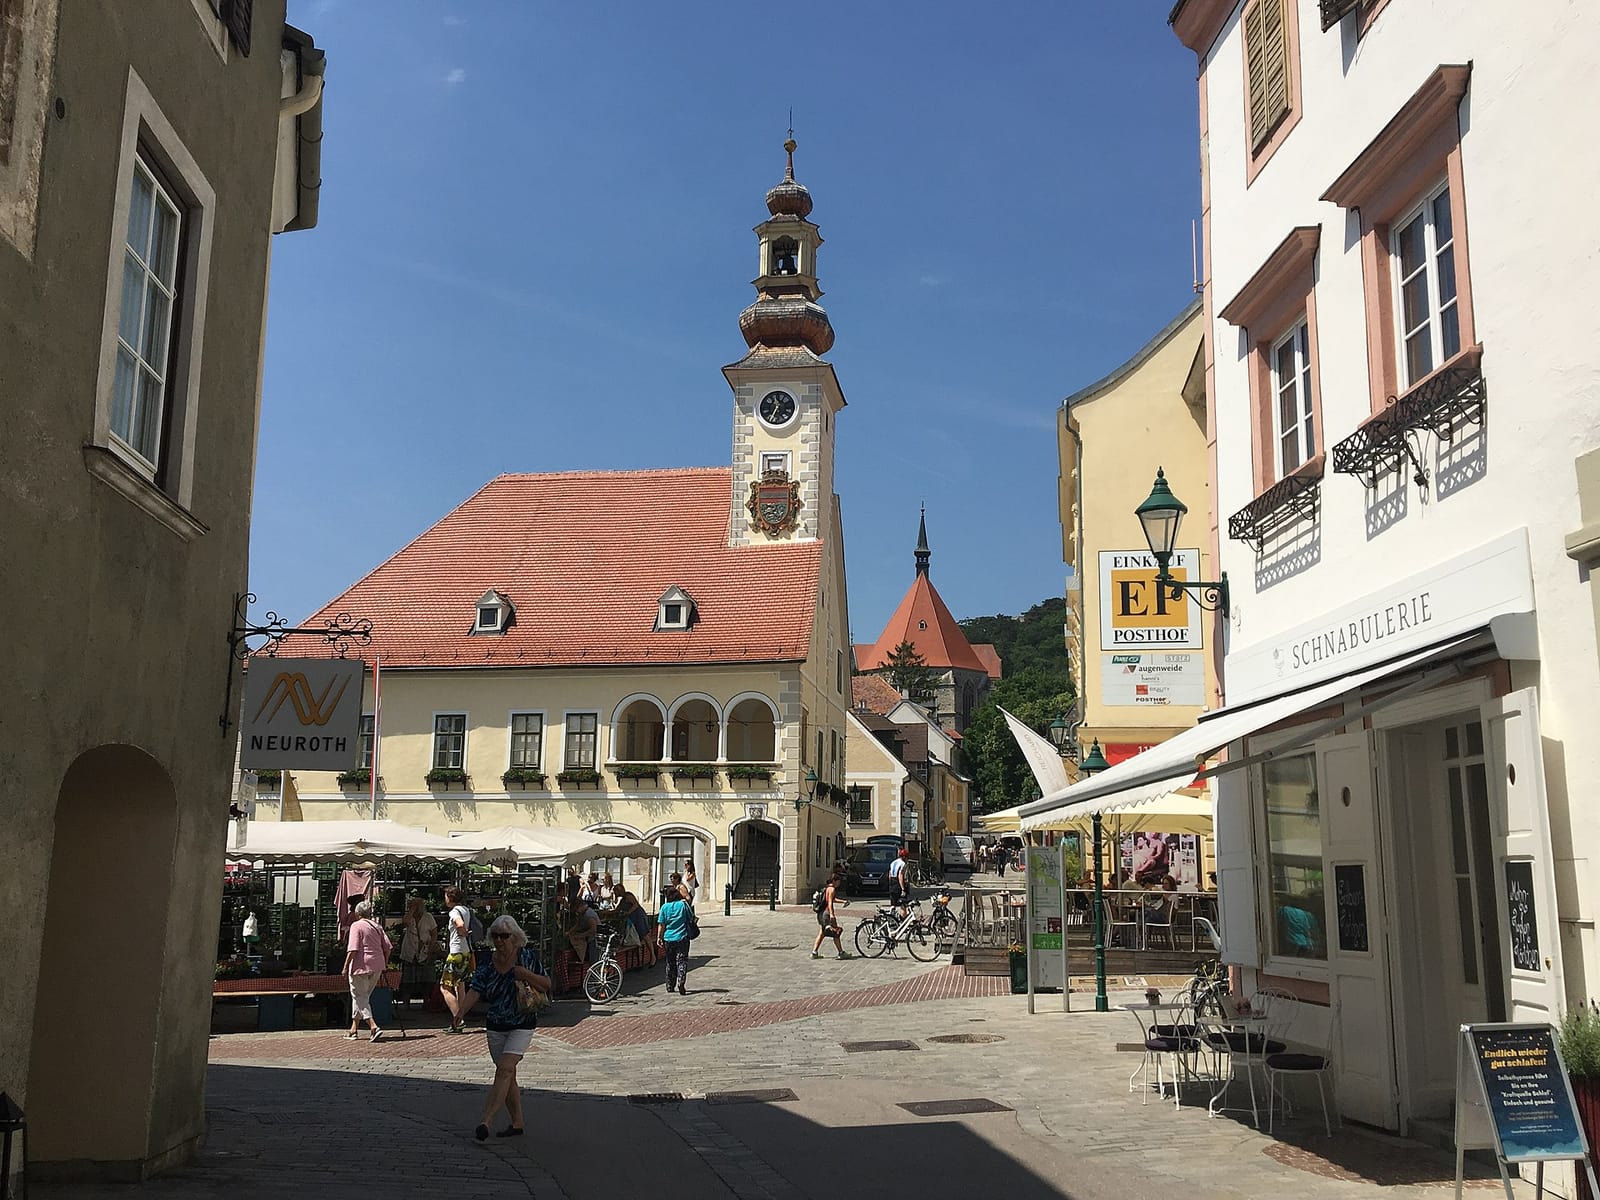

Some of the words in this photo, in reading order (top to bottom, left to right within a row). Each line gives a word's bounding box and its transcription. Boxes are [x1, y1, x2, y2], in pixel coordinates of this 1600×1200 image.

[1113, 554, 1186, 568] EINKUF
[1114, 628, 1189, 642] POSTHOF
[1292, 592, 1432, 669] SCHNABULERIE
[1138, 664, 1183, 673] augenweide
[251, 735, 347, 752] NEUROTH
[1484, 1049, 1517, 1058] Endlich
[1518, 1048, 1548, 1057] wieder
[1490, 1060, 1506, 1069] gut
[1507, 1058, 1547, 1067] schlafen!
